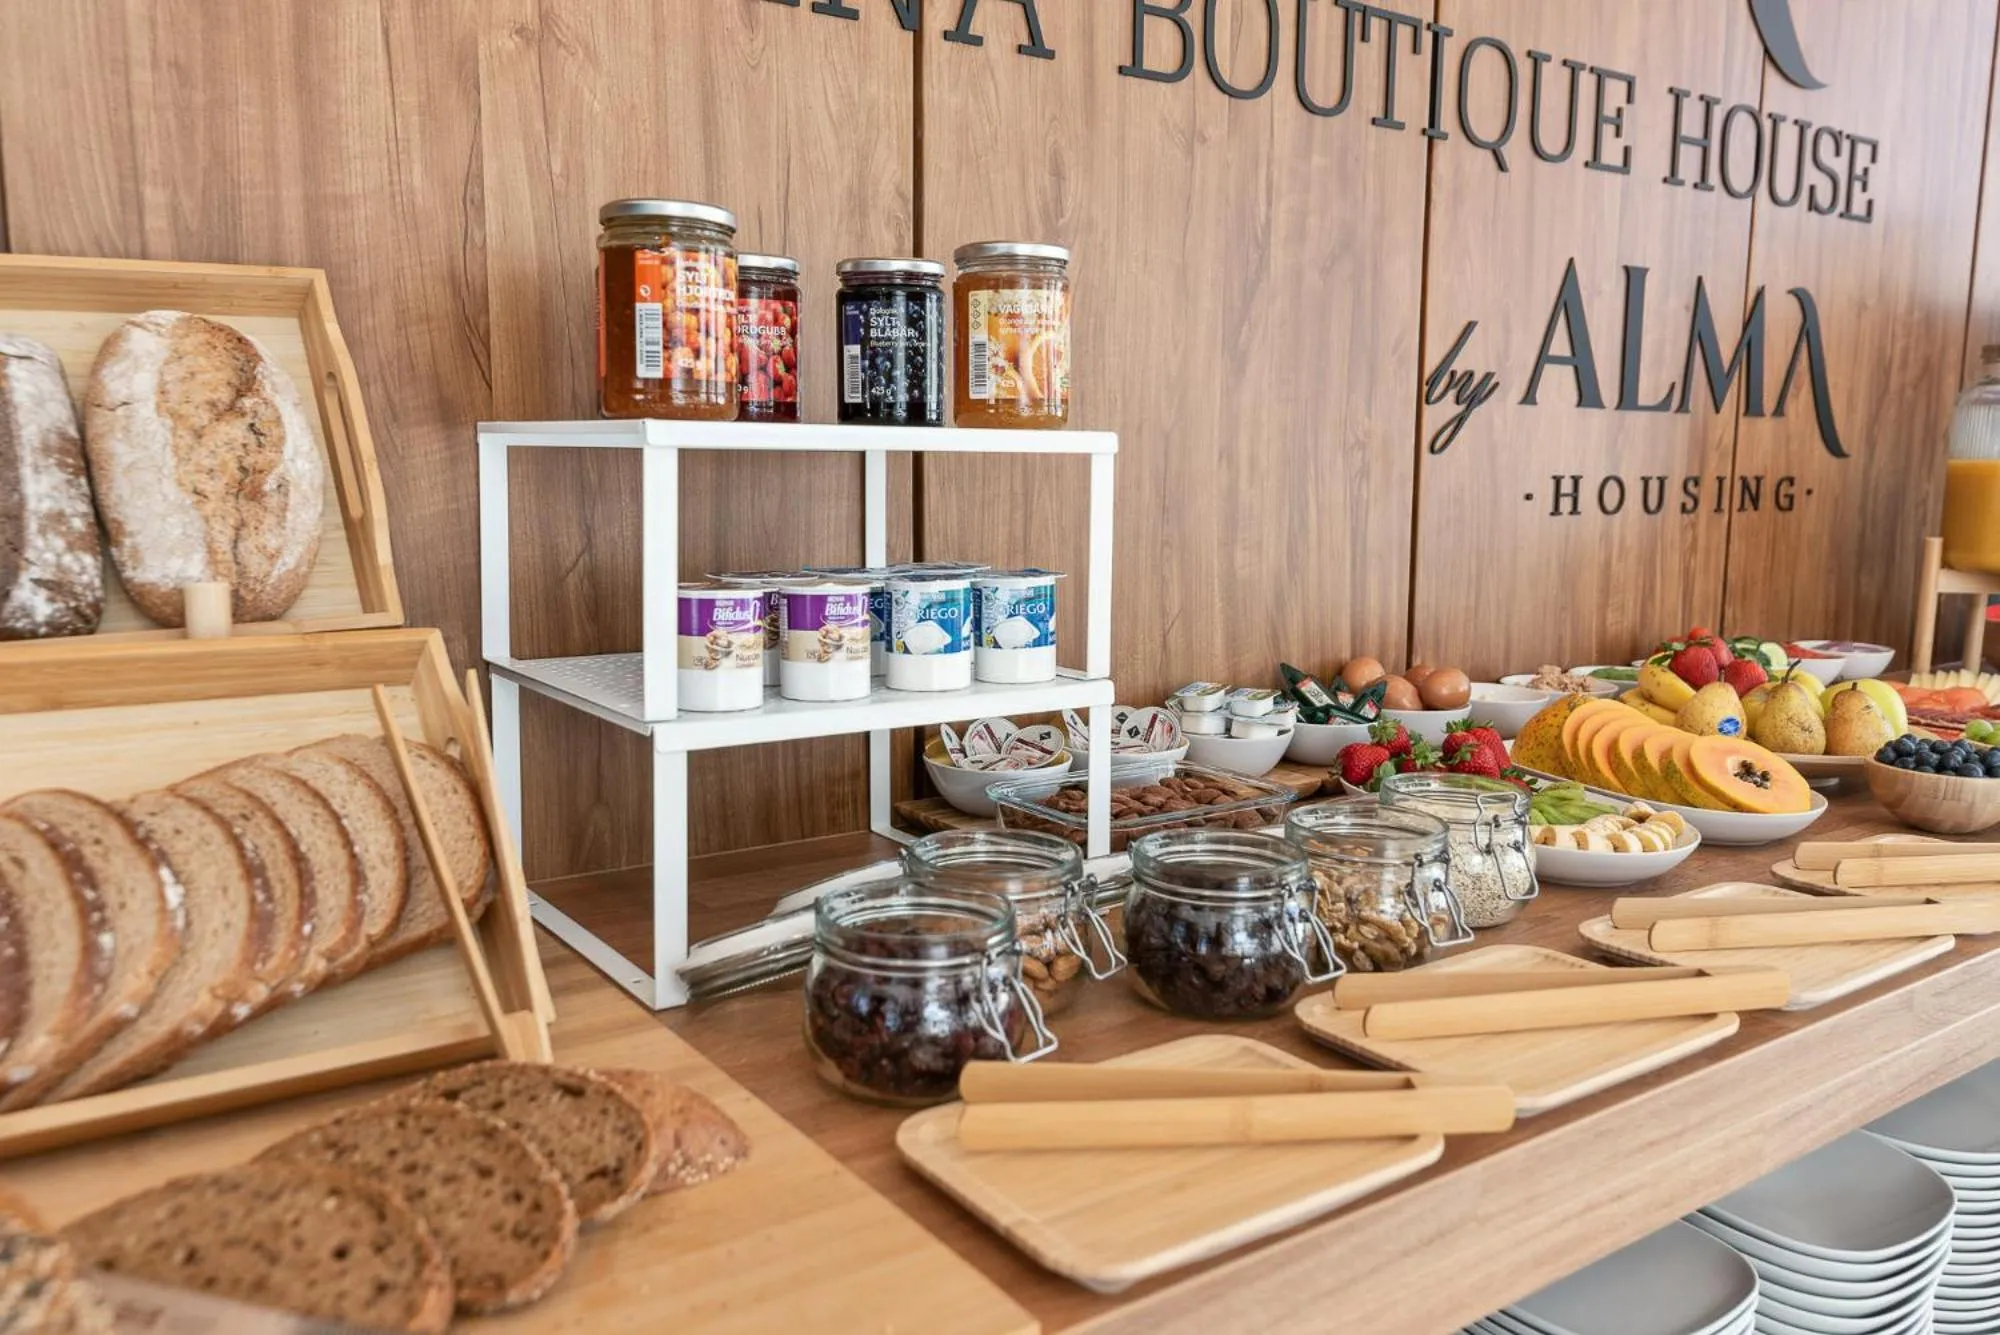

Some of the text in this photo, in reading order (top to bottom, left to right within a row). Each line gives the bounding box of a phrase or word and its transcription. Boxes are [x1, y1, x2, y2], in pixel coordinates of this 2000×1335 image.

[1118, 0, 1879, 224] BOUTIQUE HOUSE
[870, 316, 898, 327] SYLT
[1424, 256, 1850, 458] by ALMA
[910, 607, 960, 620] RIEGO
